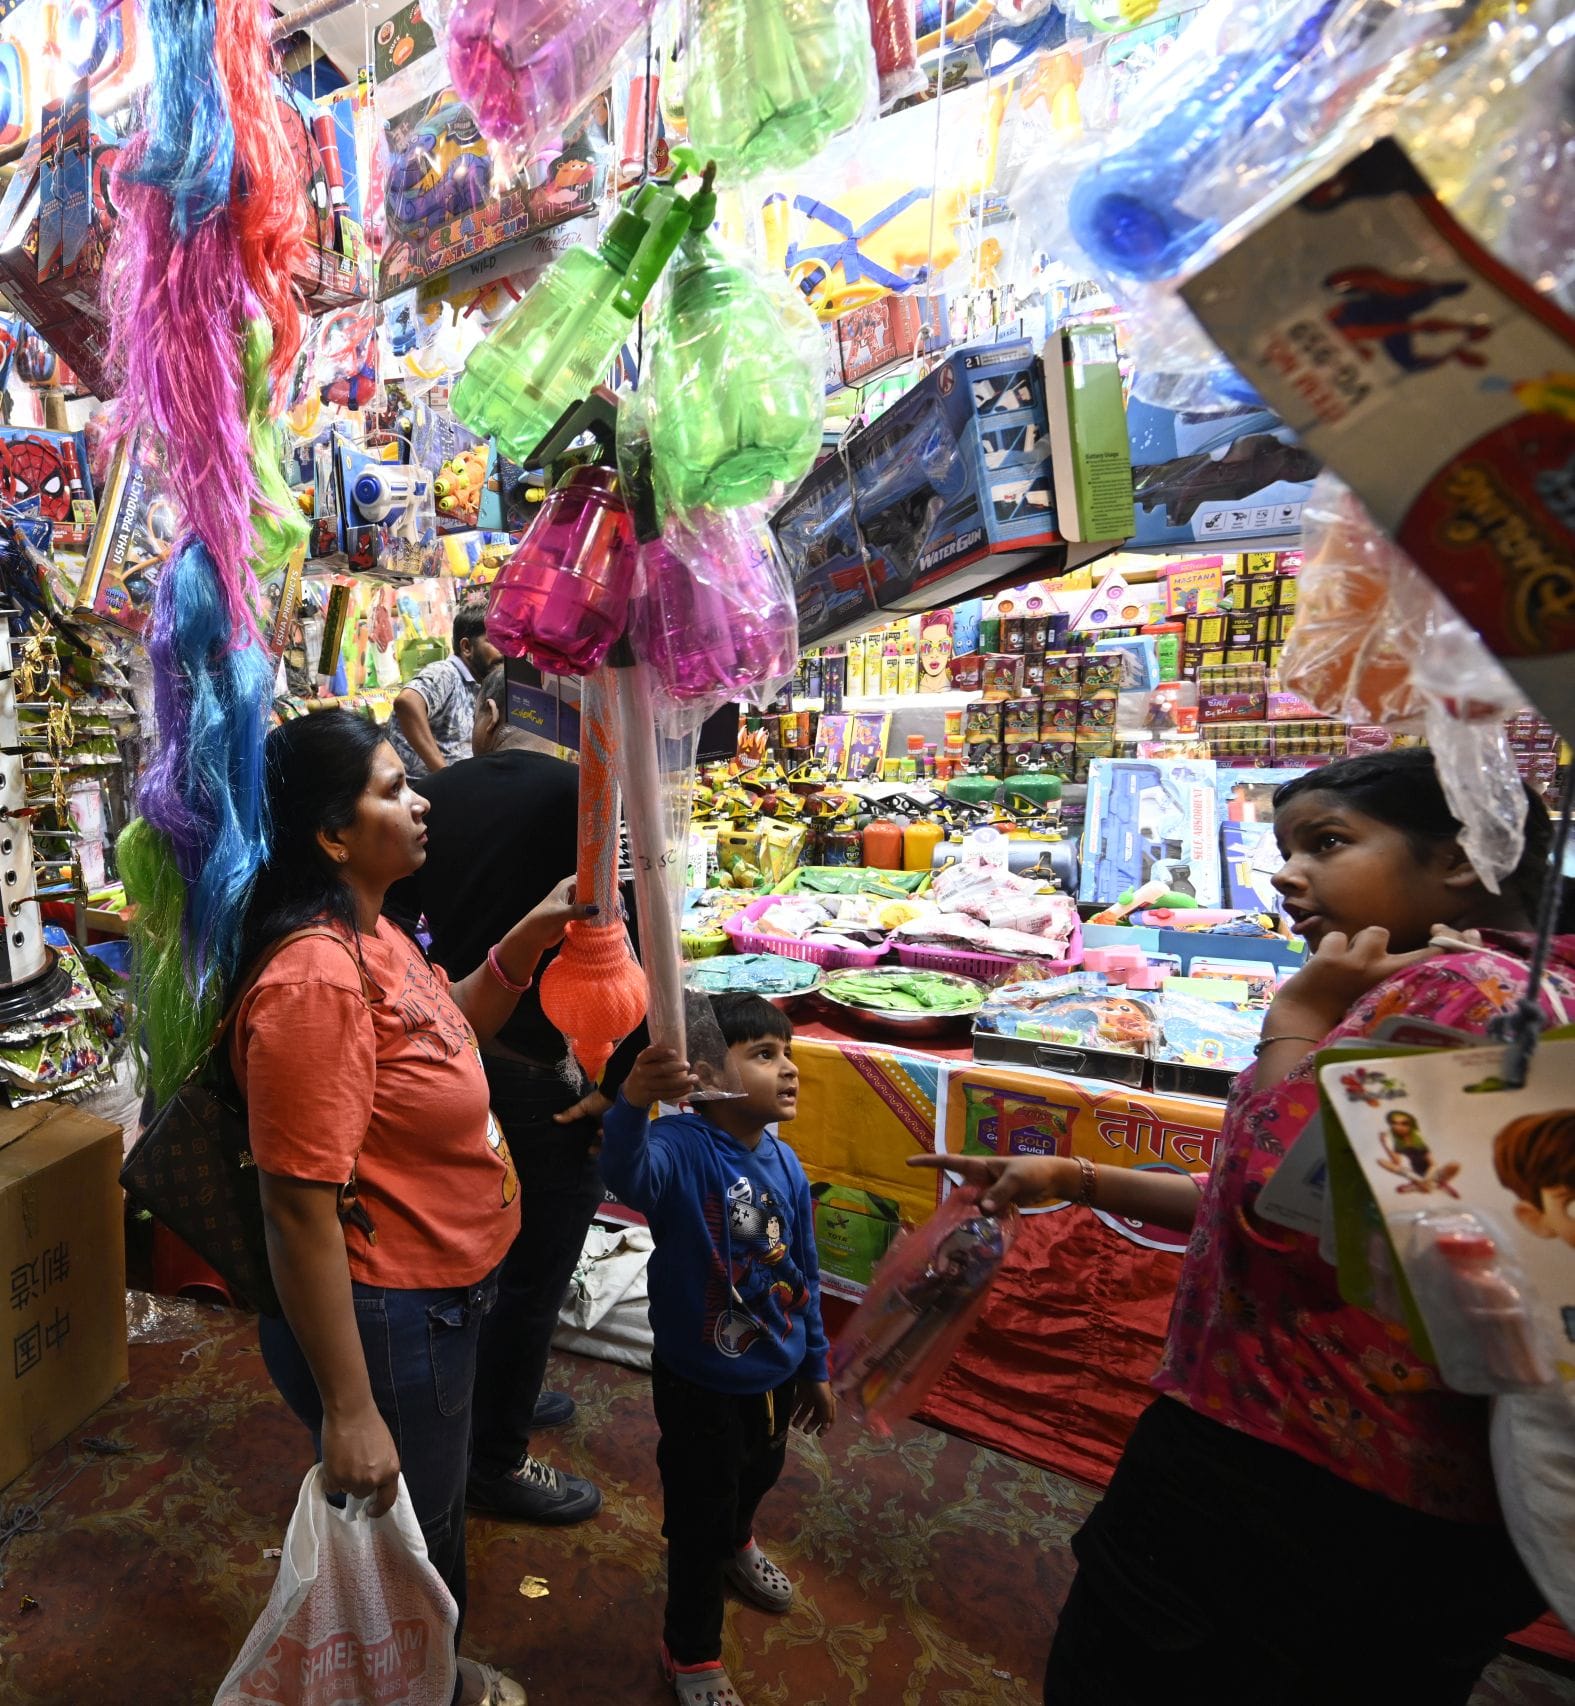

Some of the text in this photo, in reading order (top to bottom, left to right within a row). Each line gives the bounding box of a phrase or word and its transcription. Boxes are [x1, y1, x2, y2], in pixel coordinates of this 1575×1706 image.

[425, 213, 529, 275] WATER GUN
[428, 190, 526, 251] CREATURE
[470, 256, 497, 275] WILD
[113, 472, 144, 565] USHA PRODUCTS
[1174, 572, 1216, 585] MASTANA
[276, 569, 299, 646] USHA PRODUCTS
[1013, 1134, 1052, 1149] GOLD
[1018, 1144, 1045, 1155] Gulal
[1094, 1100, 1224, 1169] तोत
[301, 1640, 357, 1686] SHREE
